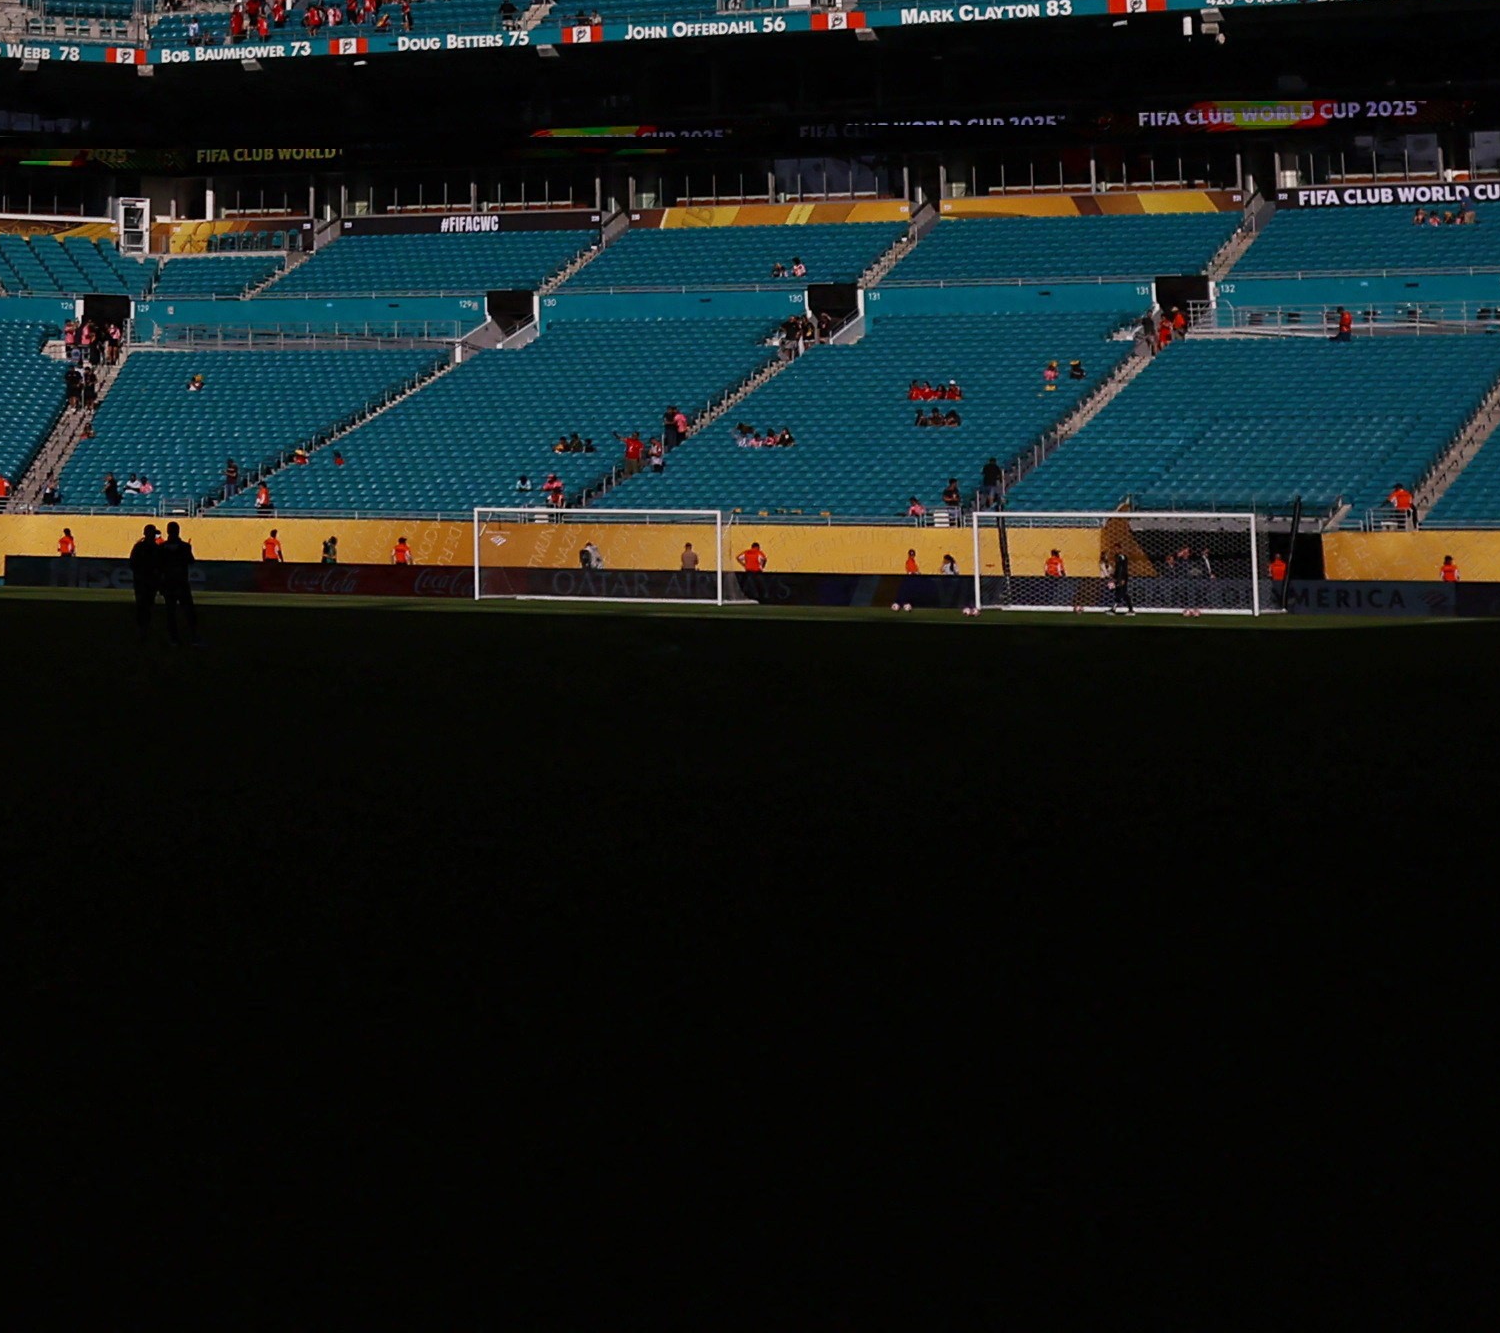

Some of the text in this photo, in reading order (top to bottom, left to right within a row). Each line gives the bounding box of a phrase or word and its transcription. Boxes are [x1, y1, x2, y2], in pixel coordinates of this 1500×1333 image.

[901, 7, 955, 25] MARK
[958, 2, 1041, 23] CLAYTON
[624, 16, 787, 41] JOHN OFFERDAHL 56
[6, 42, 51, 61] WEBB
[58, 44, 81, 62] 78
[160, 40, 312, 64] BOB BAUMHOWER 73
[397, 29, 530, 52] DOUG BETTERS 75
[1137, 110, 1181, 127] FIFA
[1184, 107, 1236, 125] CLUB
[1240, 103, 1315, 123] WORLD
[1319, 100, 1361, 120] CUP
[196, 147, 337, 165] FIFA CLUB WORLD
[1298, 188, 1339, 206] FIFA
[1342, 186, 1394, 204] CLUB
[1398, 183, 1470, 203] WORLD
[440, 215, 500, 233] #FIFACWC
[1136, 286, 1149, 295] 131
[1221, 283, 1235, 295] 132
[551, 569, 650, 596] QATAR
